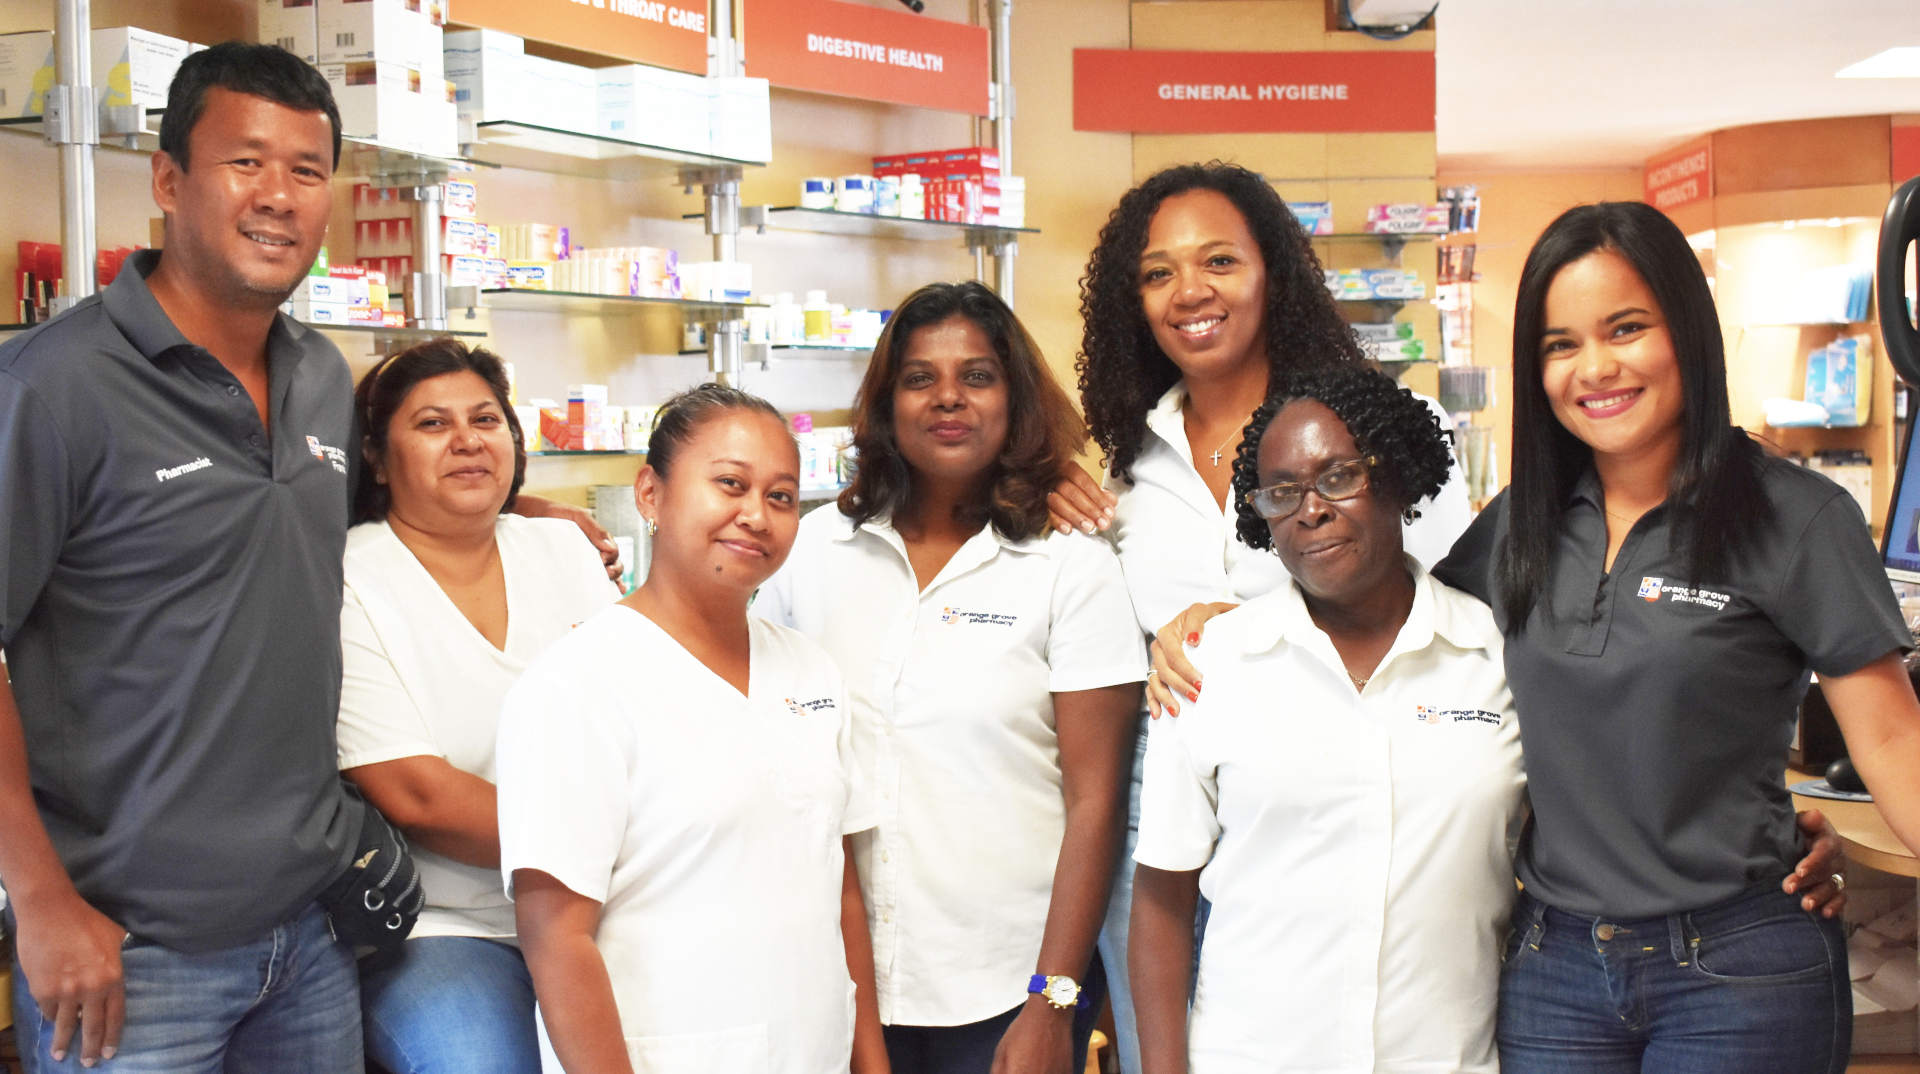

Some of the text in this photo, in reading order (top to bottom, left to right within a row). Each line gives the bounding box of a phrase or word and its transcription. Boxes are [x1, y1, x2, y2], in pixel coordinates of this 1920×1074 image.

[610, 0, 705, 33] THROAT CARE
[807, 33, 943, 72] DIGESTIVE HEALTH
[1158, 83, 1349, 100] GENERAL HYGIENE
[155, 457, 214, 482] Pharmacist
[1671, 593, 1725, 611] pharmacy
[1698, 589, 1731, 602] grove
[960, 611, 1018, 620] orange grove
[969, 617, 1014, 627] pharmacy
[1453, 715, 1501, 726] pharmacy
